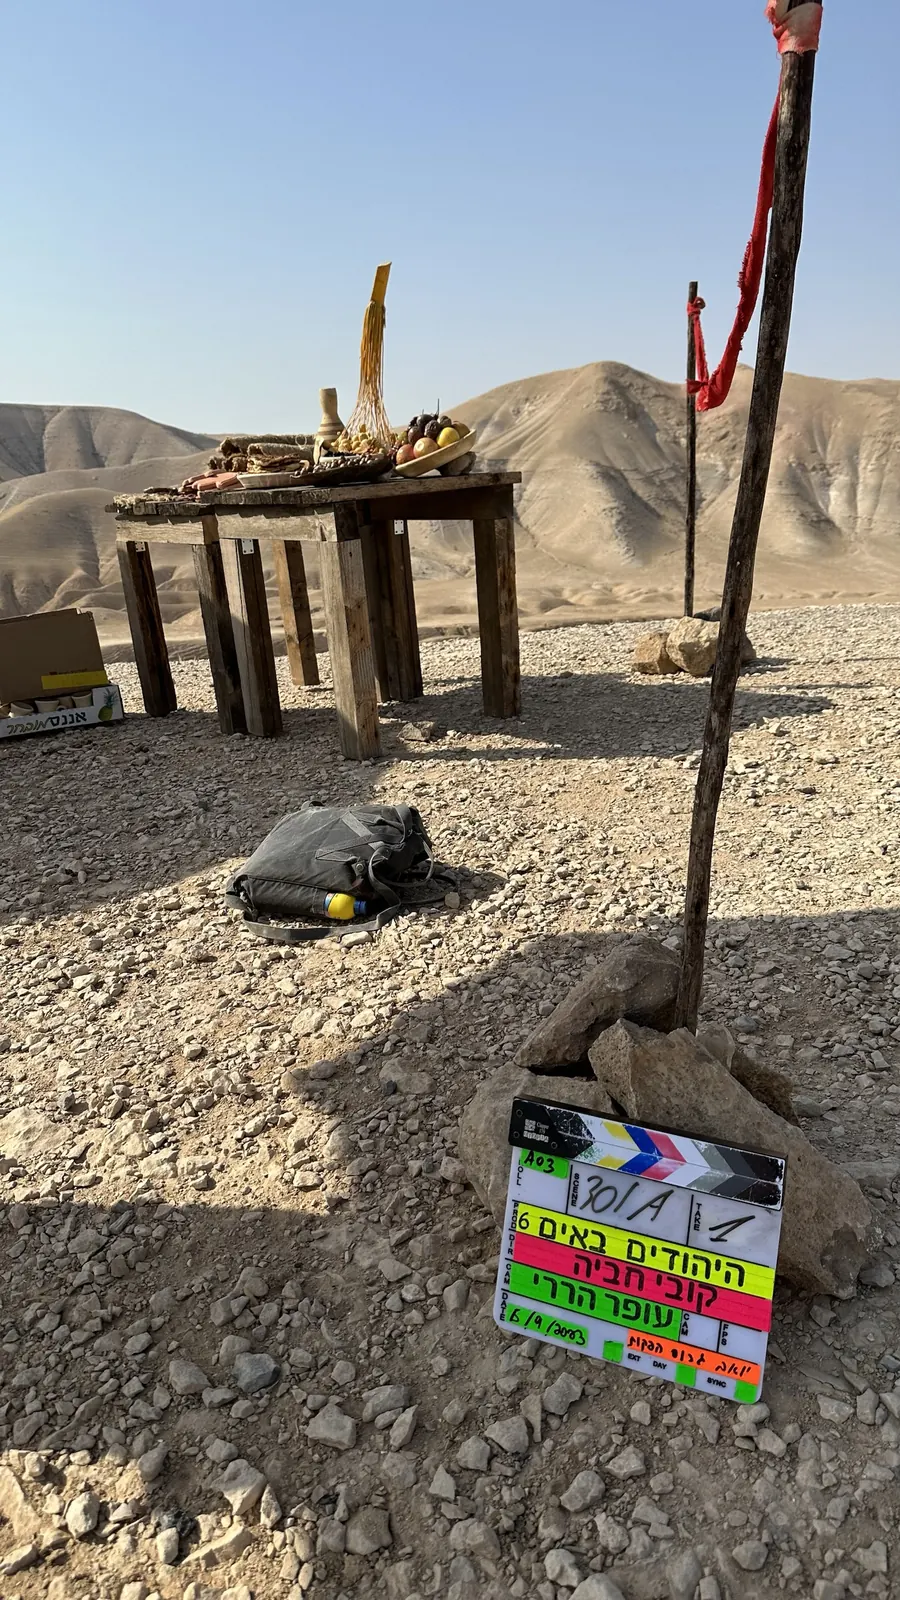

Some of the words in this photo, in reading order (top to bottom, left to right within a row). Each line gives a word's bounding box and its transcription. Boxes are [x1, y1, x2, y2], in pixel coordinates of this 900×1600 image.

[7, 717, 49, 735] מובחר
[48, 712, 87, 727] אננס
[516, 1159, 524, 1186] OLL
[524, 1150, 555, 1174] A03
[572, 1173, 580, 1207] SCENE
[511, 1202, 519, 1229] PROD
[518, 1212, 530, 1230] 6
[694, 1203, 702, 1231] TAKE
[708, 1215, 756, 1242] 1
[507, 1234, 515, 1255] DIR
[539, 1216, 607, 1254] באים
[504, 1263, 512, 1285] CAM
[573, 1254, 645, 1291] חביה
[626, 1238, 745, 1287] היהודים
[533, 1272, 597, 1311] הררי
[655, 1273, 718, 1314] קובי
[500, 1292, 508, 1321] DATE
[604, 1293, 674, 1329] עופר
[681, 1313, 690, 1336] CAM
[721, 1324, 729, 1346] FPS
[627, 1353, 641, 1362] EXT
[653, 1360, 667, 1370] DAY
[707, 1377, 727, 1388] SYNC
